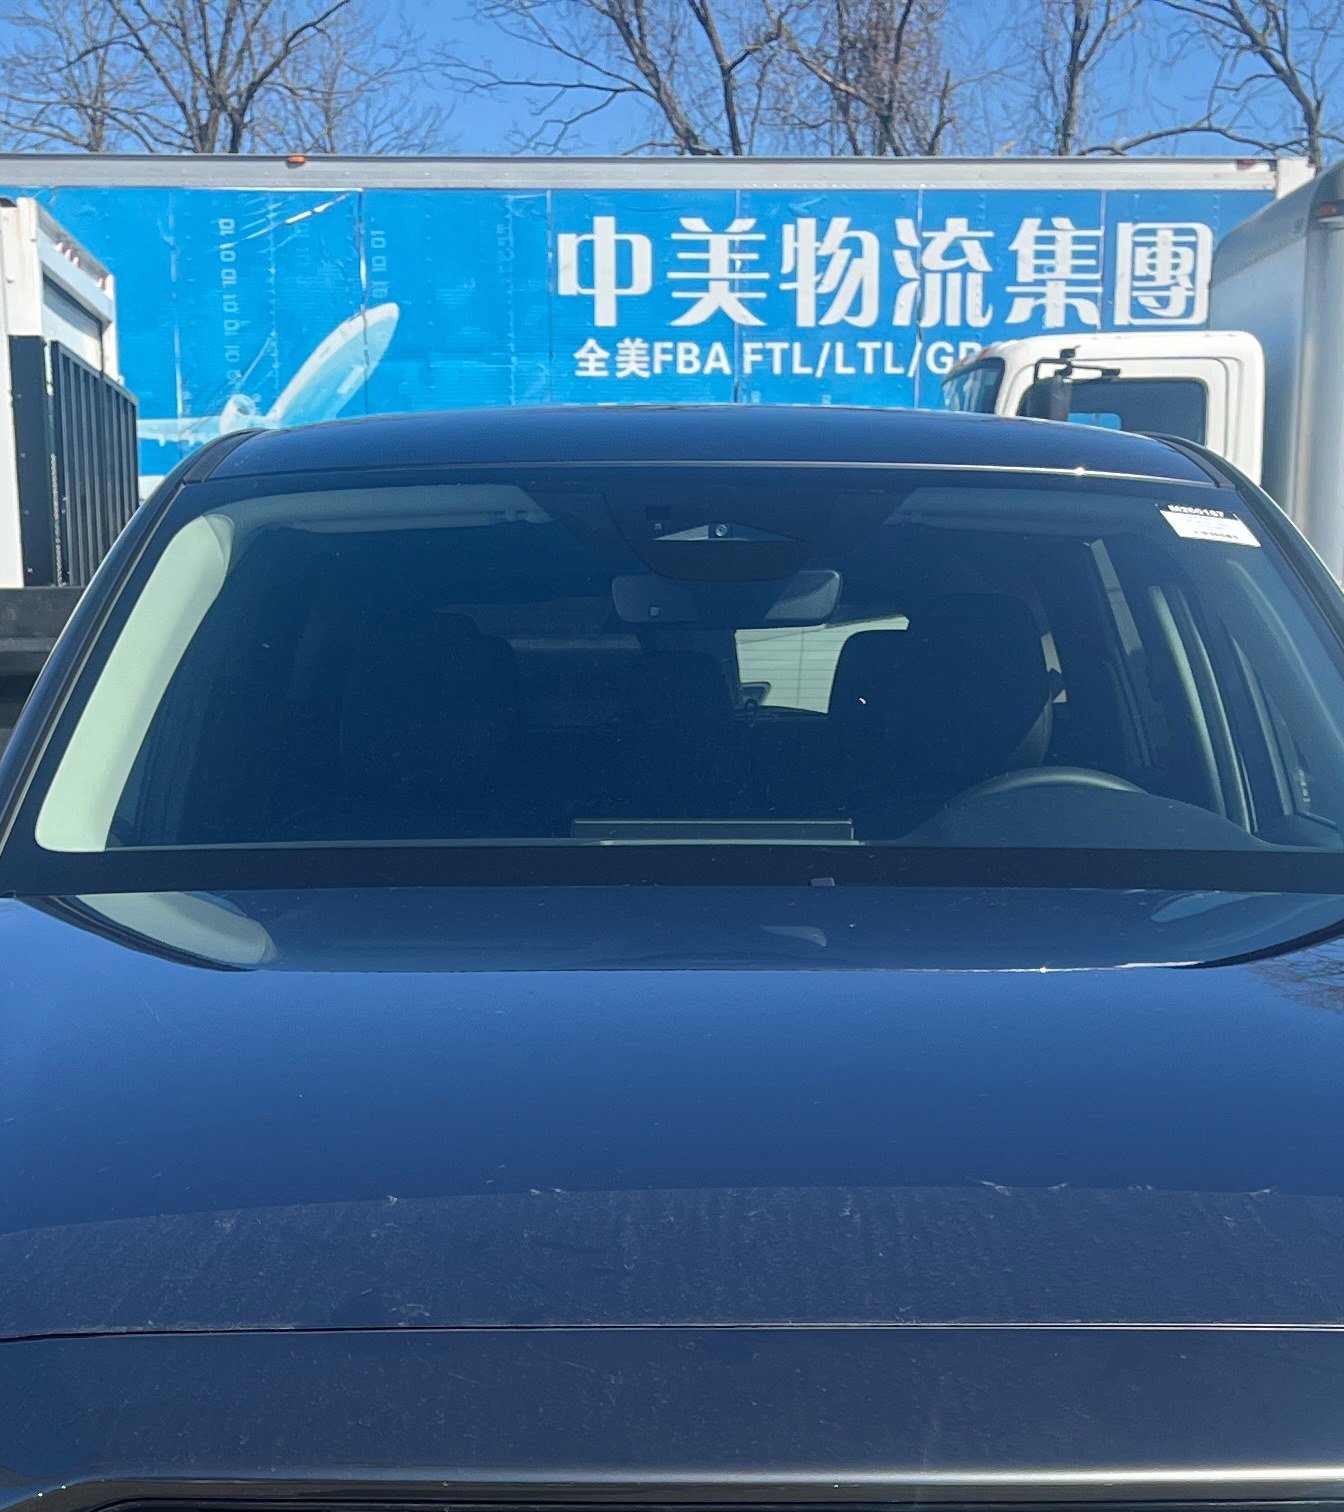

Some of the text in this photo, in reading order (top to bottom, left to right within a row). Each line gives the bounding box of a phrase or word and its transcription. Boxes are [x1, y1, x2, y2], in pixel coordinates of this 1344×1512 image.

[558, 216, 1214, 328] 中美物流集團
